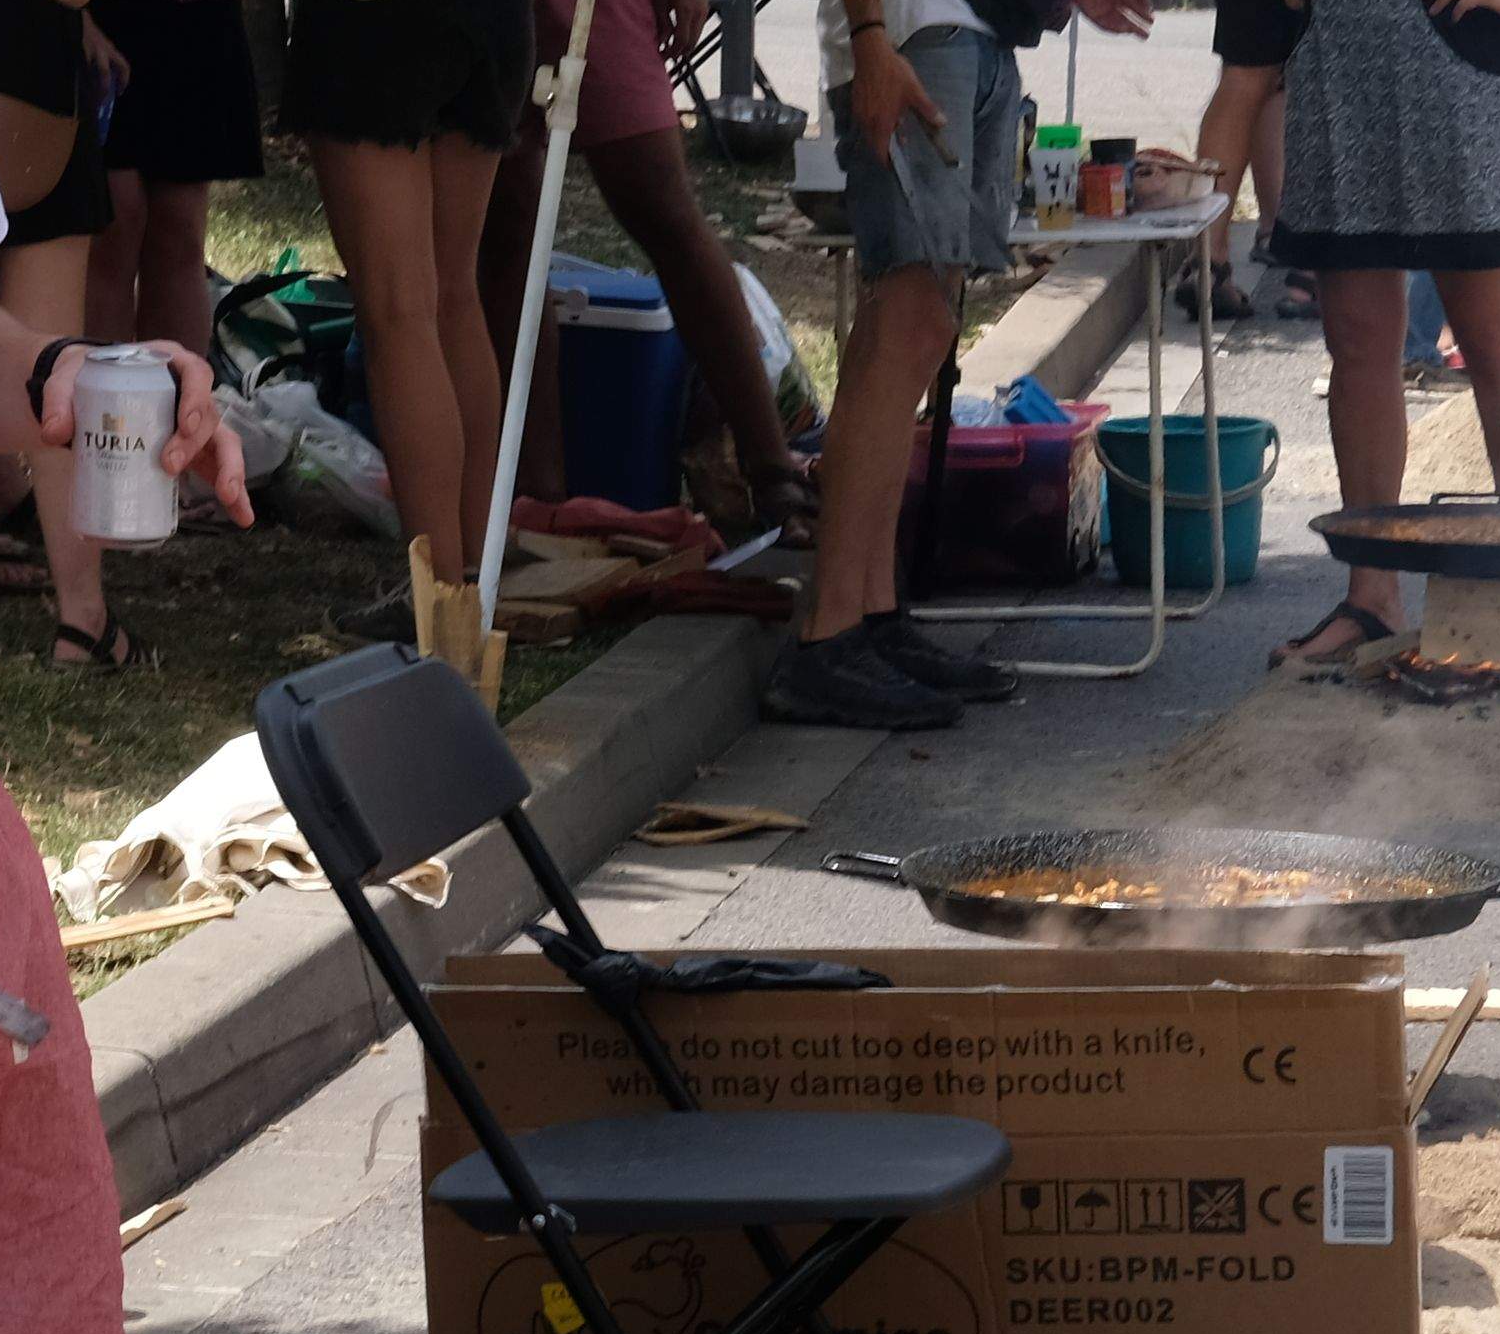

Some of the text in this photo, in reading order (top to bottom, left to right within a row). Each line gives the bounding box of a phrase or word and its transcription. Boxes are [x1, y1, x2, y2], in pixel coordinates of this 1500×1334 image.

[84, 431, 145, 452] TURIA
[681, 1032, 719, 1059] do
[729, 1034, 783, 1059] not
[792, 1033, 841, 1059] cut
[851, 1033, 902, 1059] too
[913, 1030, 995, 1064] deep
[1005, 1029, 1073, 1057] with
[1084, 1033, 1103, 1057] a
[1113, 1026, 1207, 1058] knife,
[712, 1075, 780, 1104] may
[789, 1070, 923, 1103] damage
[934, 1069, 986, 1096] the
[995, 1067, 1126, 1101] product
[1004, 1255, 1296, 1285] SKU:BPM-FOLD
[1008, 1297, 1176, 1326] DEER002
